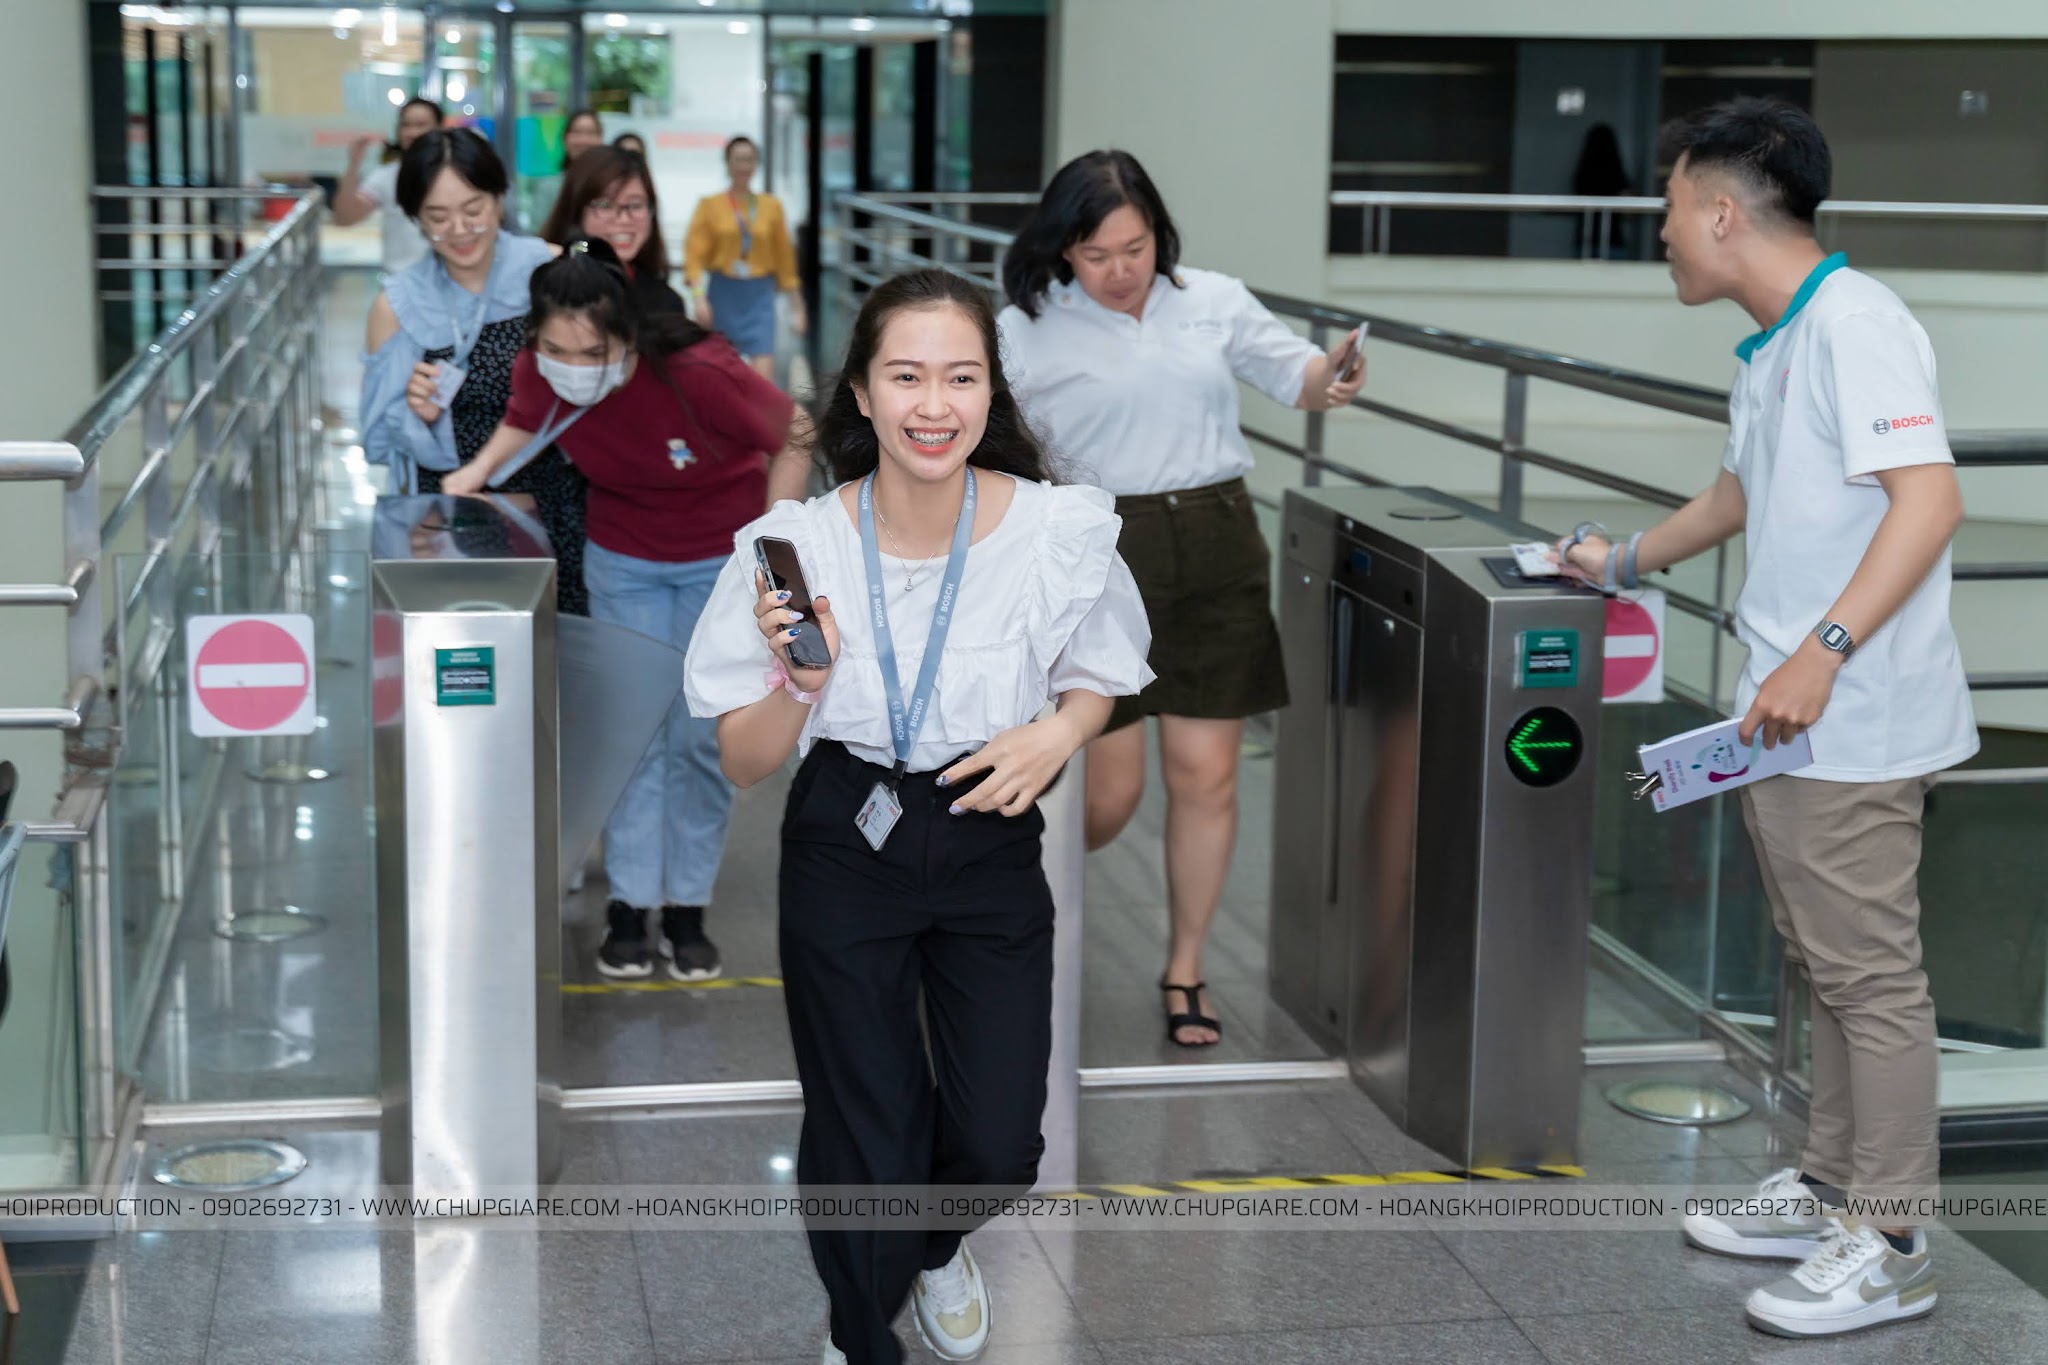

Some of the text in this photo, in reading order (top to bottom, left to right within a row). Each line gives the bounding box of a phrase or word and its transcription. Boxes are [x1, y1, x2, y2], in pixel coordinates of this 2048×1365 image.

[1891, 414, 1935, 430] BOSCH
[861, 481, 870, 510] BOSCH
[874, 597, 885, 628] BOSCH
[940, 582, 955, 613] BOSCH
[894, 713, 905, 741] BOSCH
[909, 697, 924, 728] BOSCH
